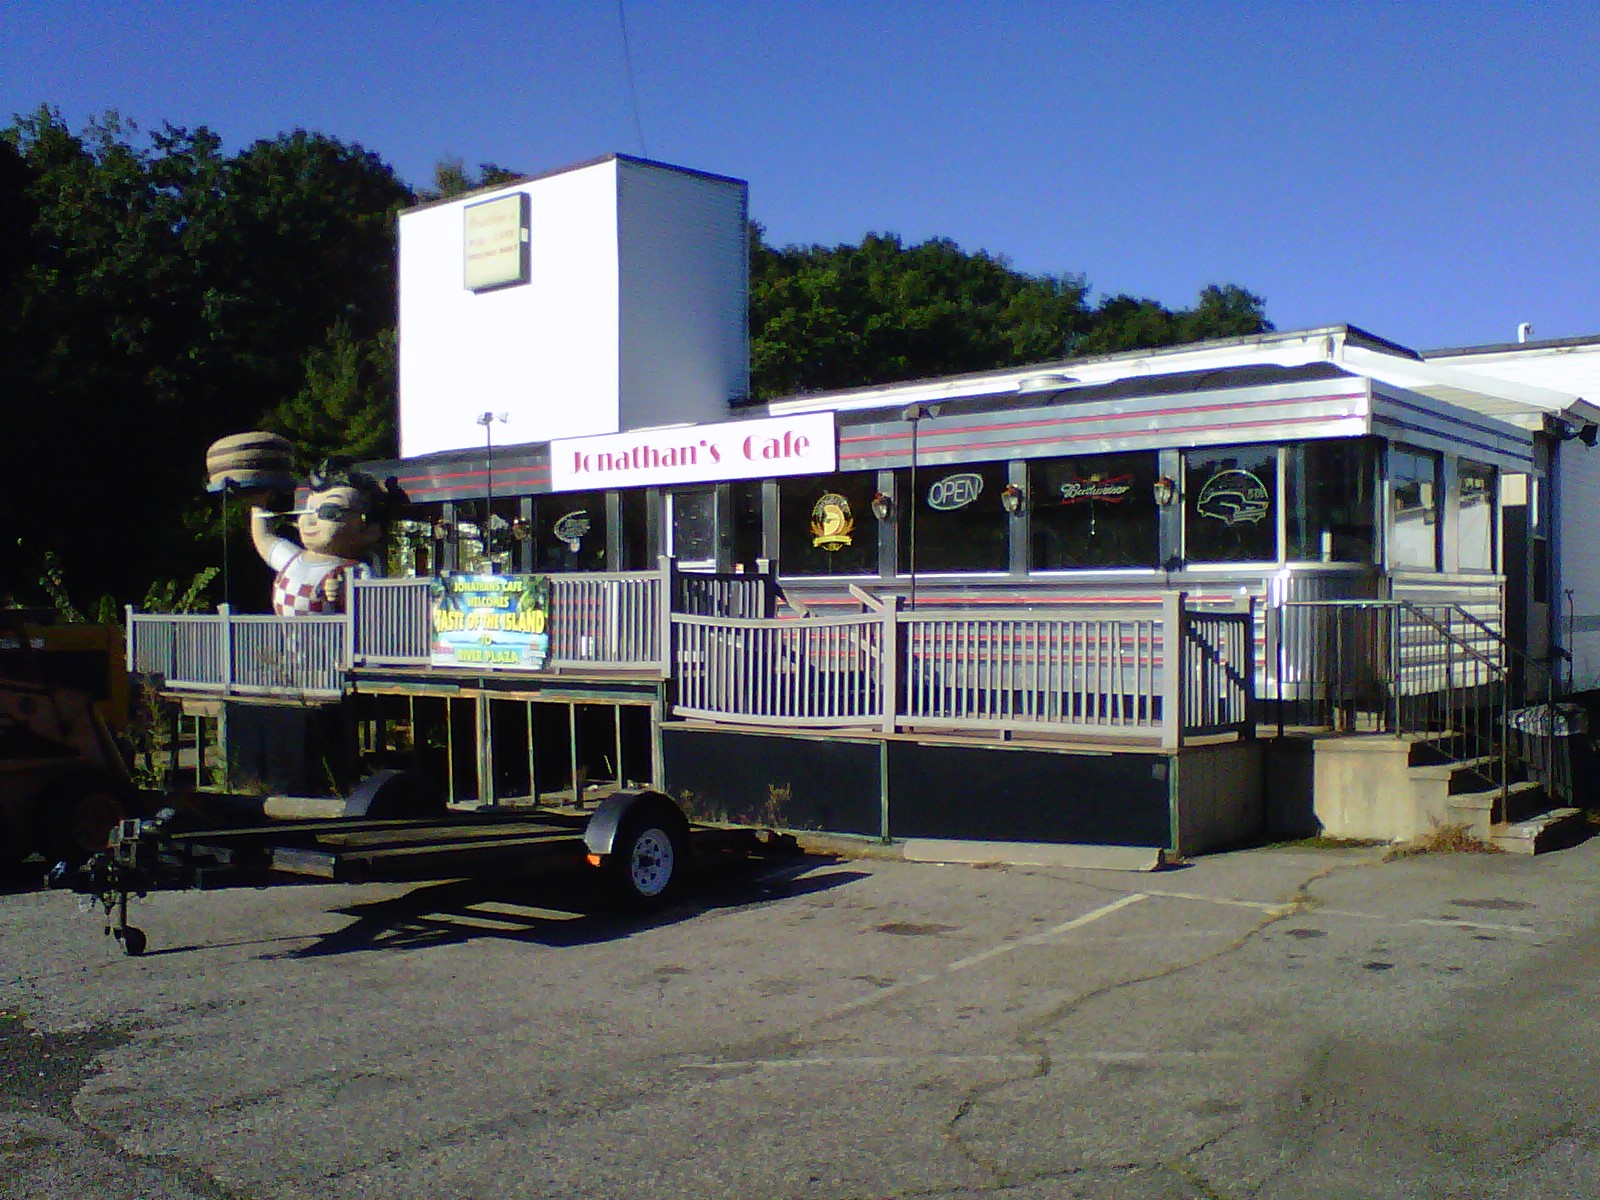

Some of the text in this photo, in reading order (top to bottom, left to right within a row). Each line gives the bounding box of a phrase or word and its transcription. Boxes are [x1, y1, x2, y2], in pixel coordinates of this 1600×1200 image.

[570, 430, 810, 475] Jonathan's Cafe
[930, 479, 979, 504] OPEN
[467, 596, 510, 608] WELCOMES
[433, 609, 545, 634] TASTE OF THE ISLAND
[482, 635, 493, 646] TO
[486, 650, 520, 664] PLAZA
